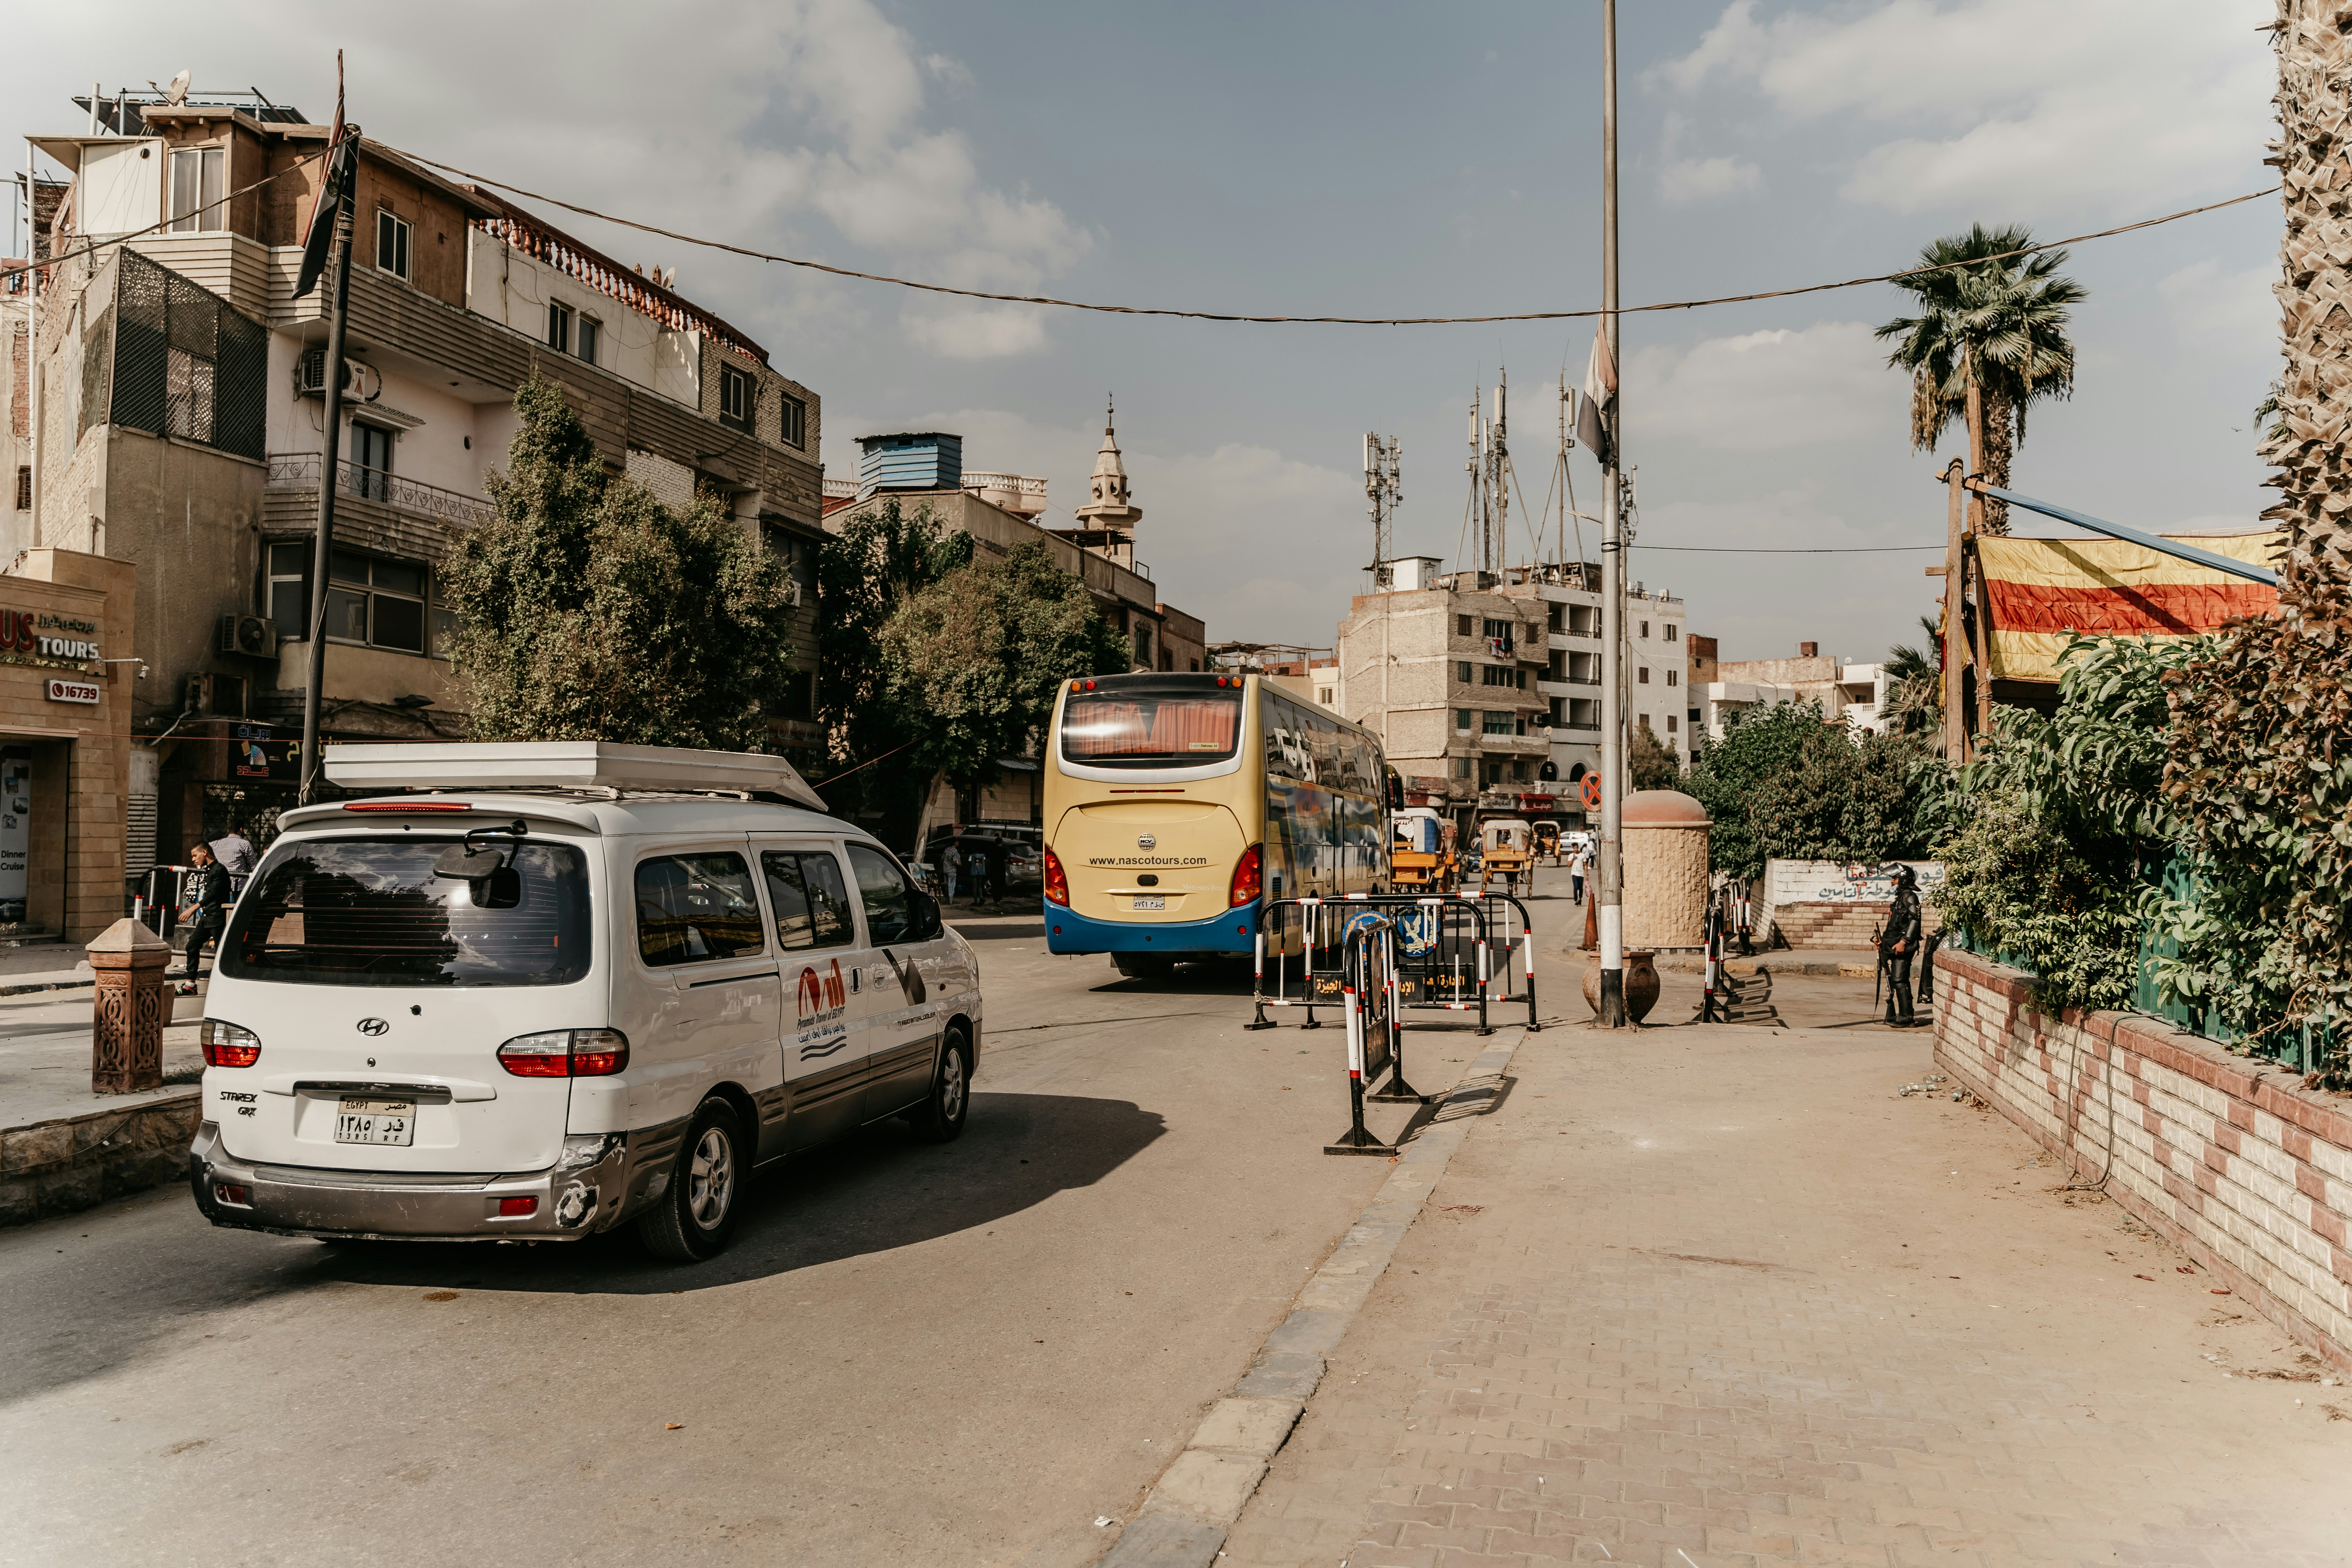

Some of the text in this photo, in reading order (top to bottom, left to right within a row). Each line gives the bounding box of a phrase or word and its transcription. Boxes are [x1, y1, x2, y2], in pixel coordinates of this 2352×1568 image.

[40, 636, 99, 659] TOURS
[65, 686, 97, 700] 16739
[238, 725, 270, 742] بويات
[1, 850, 26, 858] Dinner
[1089, 856, 1207, 865] www.nascotours.com
[0, 862, 25, 870] Cruise
[1316, 978, 1341, 994] الجيزة
[797, 1006, 845, 1031] Pyramids Travel of EGYPT
[220, 1091, 258, 1103] STAREX
[238, 1106, 258, 1118] GRX
[346, 1101, 369, 1110] EGYPT
[339, 1115, 371, 1132] ١٣٨٥
